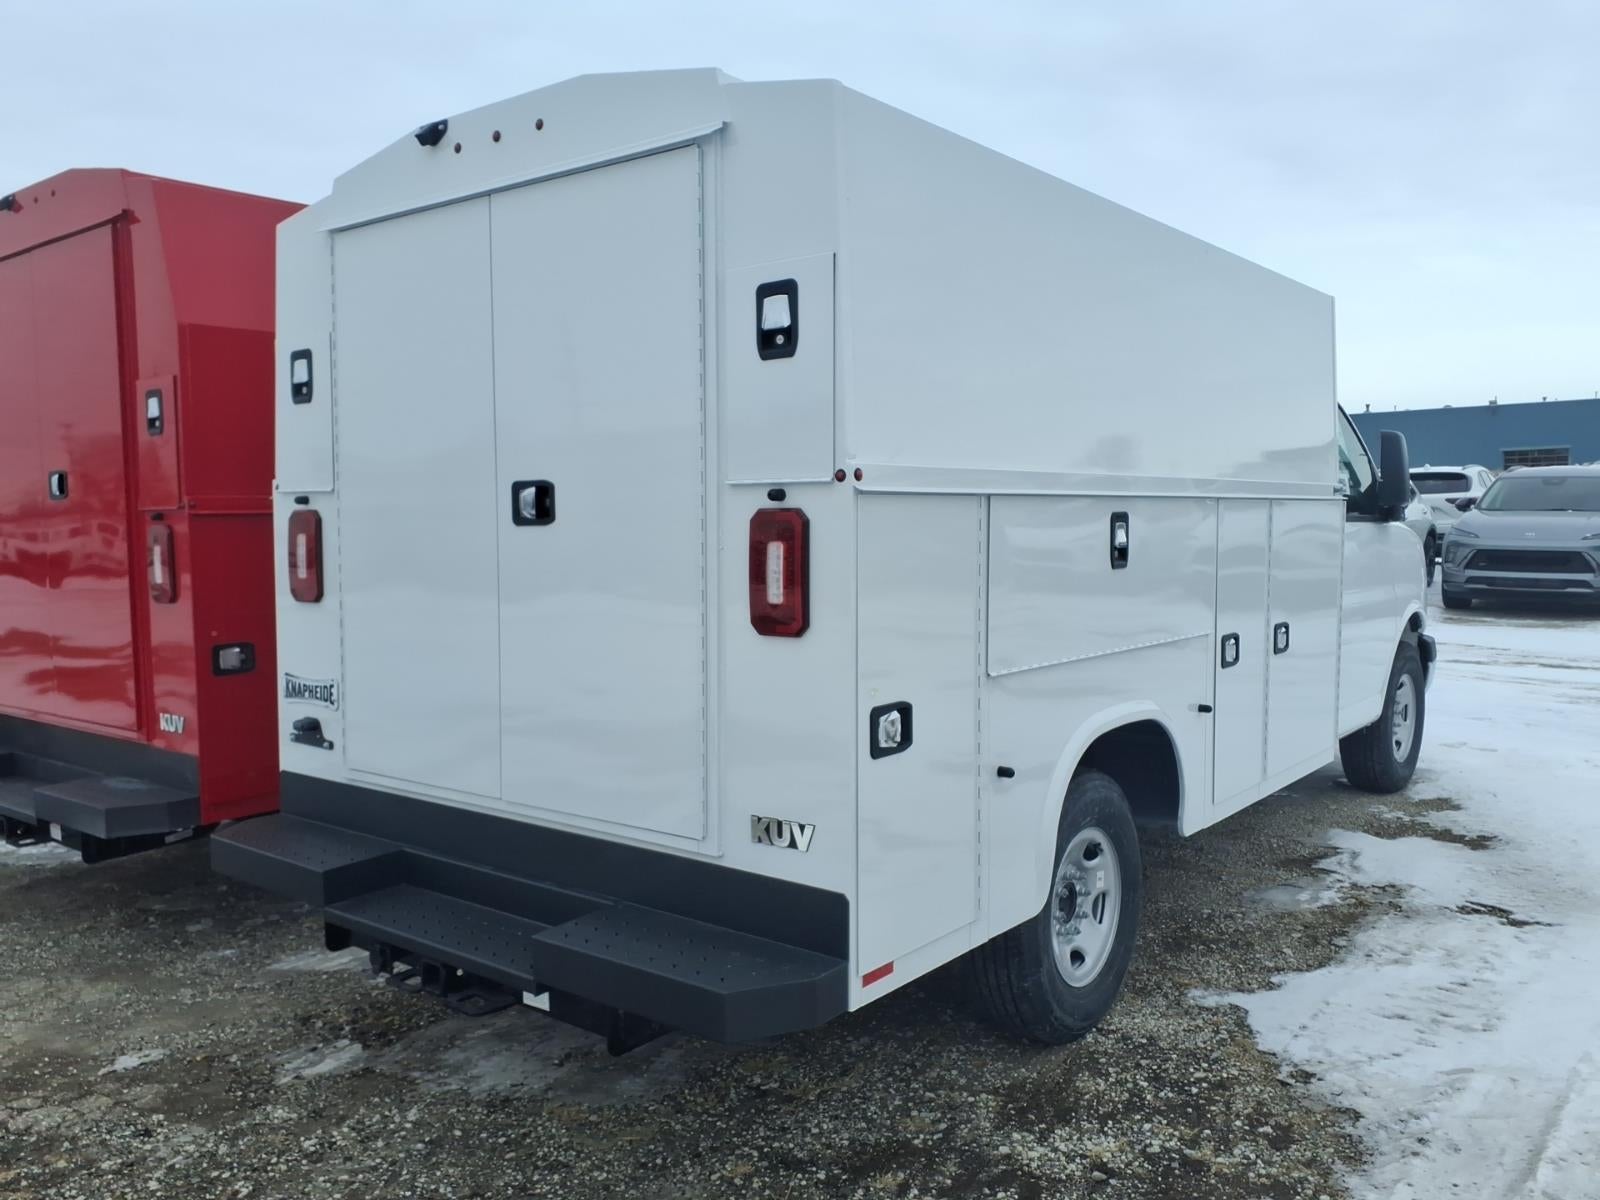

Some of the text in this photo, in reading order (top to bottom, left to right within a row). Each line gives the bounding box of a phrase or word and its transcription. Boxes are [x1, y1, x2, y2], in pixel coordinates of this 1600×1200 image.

[285, 678, 335, 706] KNAPHEIDE
[159, 712, 185, 734] KUV
[751, 814, 816, 852] KUV
